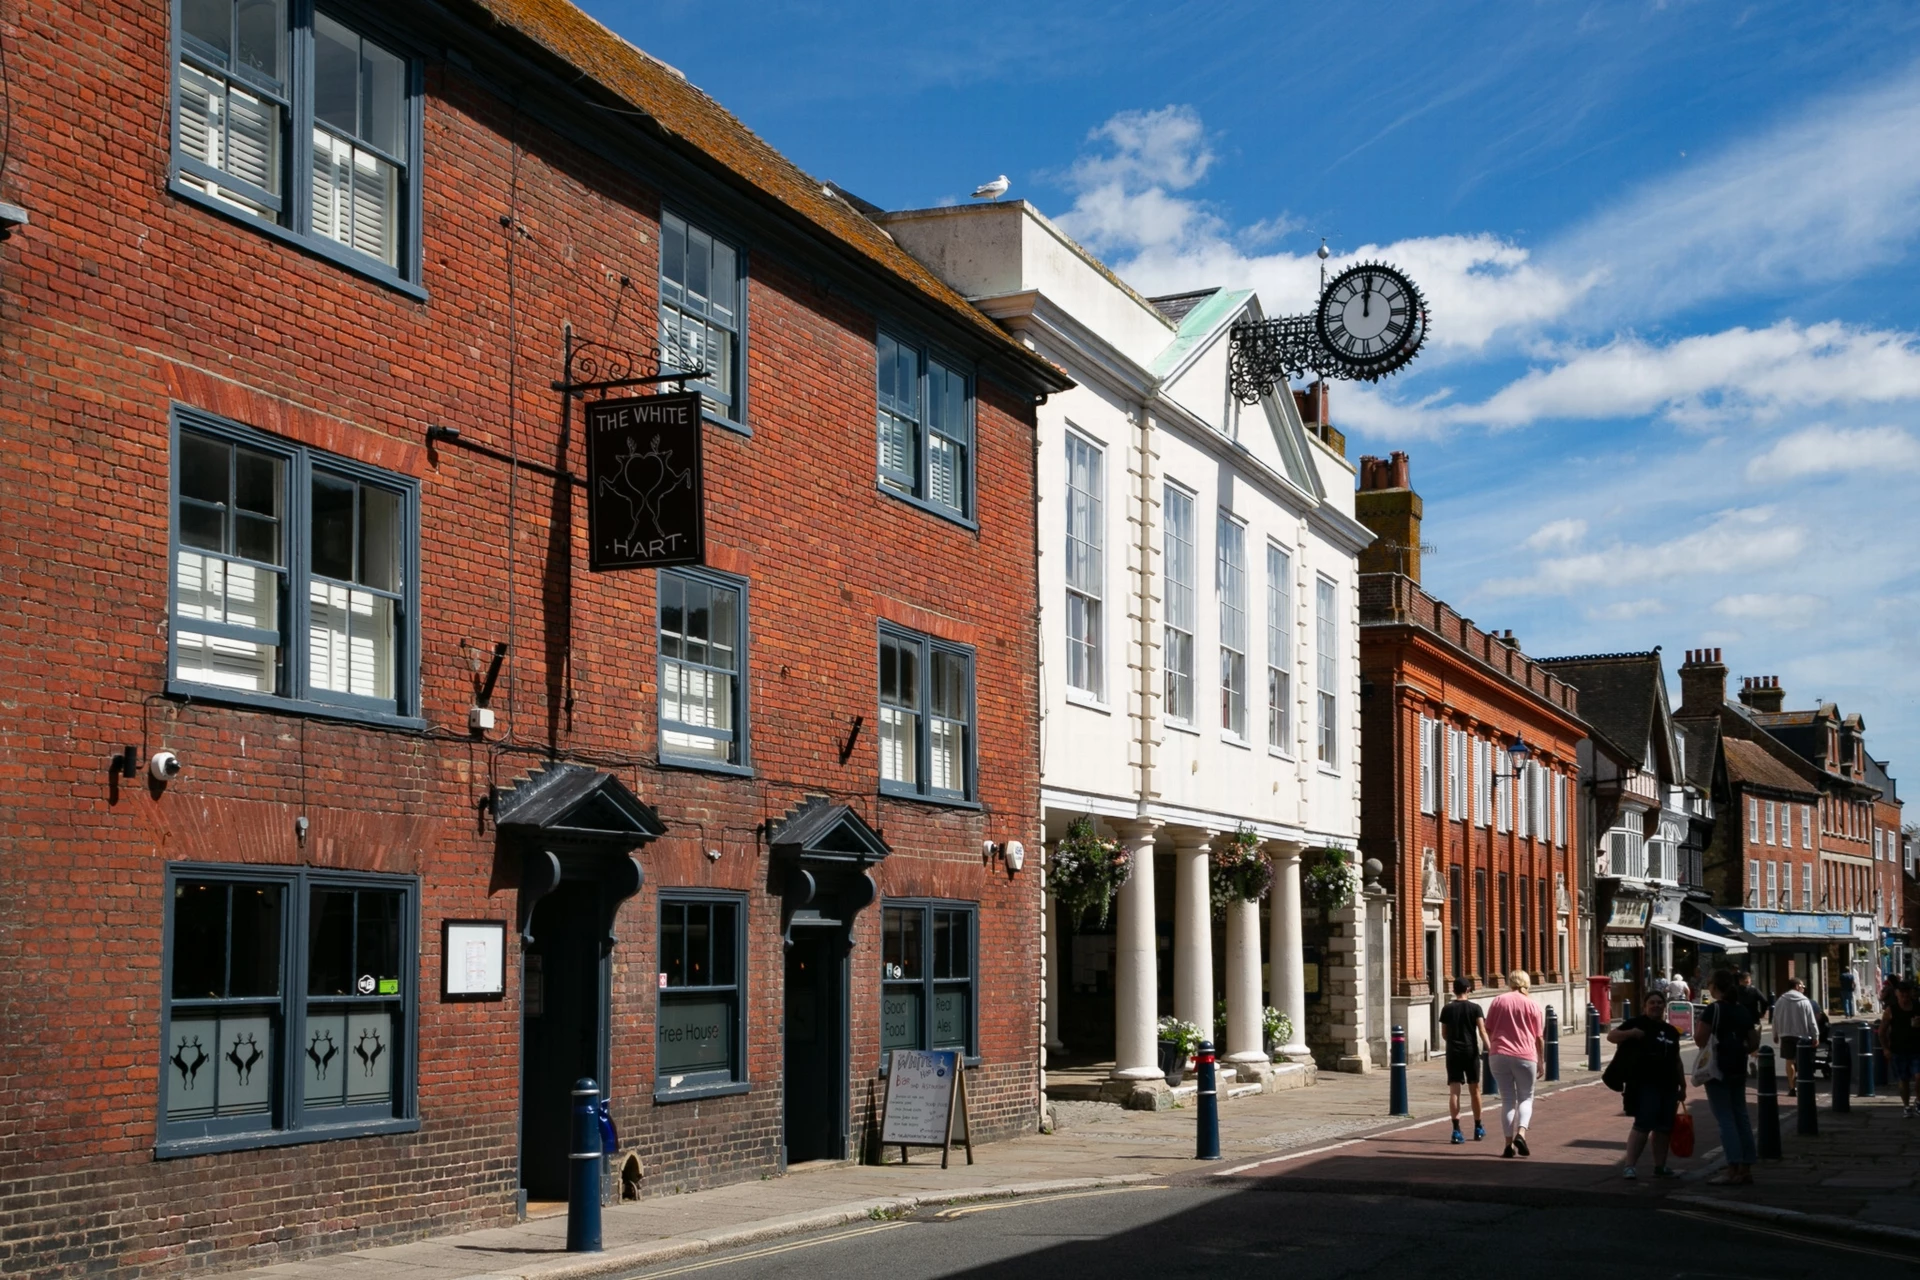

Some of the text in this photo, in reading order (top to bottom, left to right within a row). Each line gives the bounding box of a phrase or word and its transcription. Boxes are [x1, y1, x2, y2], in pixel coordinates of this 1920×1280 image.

[596, 406, 688, 433] THE WHITE
[614, 533, 682, 558] HART
[884, 999, 907, 1015] Good
[935, 997, 952, 1012] Real
[659, 1023, 719, 1043] Free House
[885, 1022, 906, 1037] Food
[936, 1018, 952, 1033] Ales
